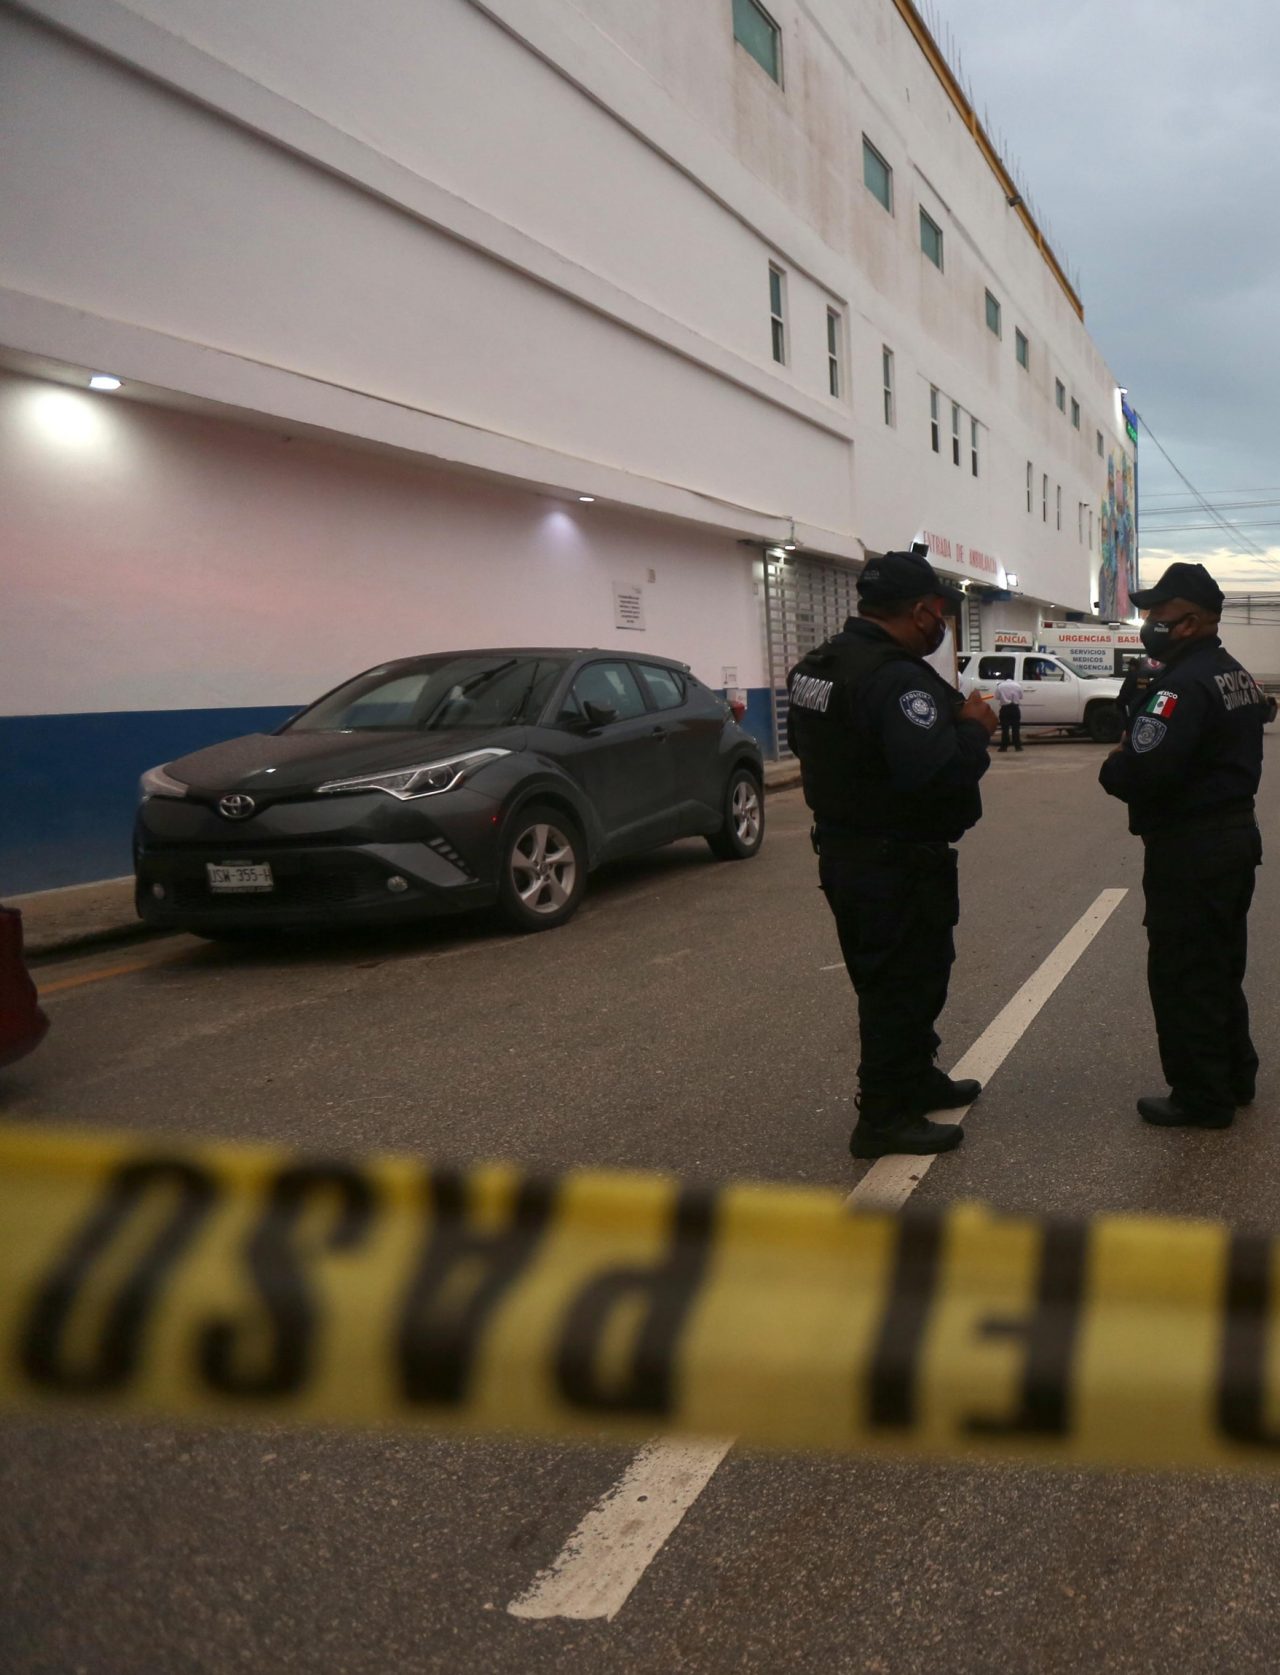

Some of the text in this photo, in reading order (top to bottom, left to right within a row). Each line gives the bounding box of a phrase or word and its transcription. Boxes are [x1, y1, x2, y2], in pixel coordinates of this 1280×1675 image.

[923, 530, 951, 559] ENTRADA
[956, 543, 964, 563] DE
[1058, 634, 1112, 643] URGENCIAS
[1070, 648, 1106, 656] SERVICIOS
[18, 1153, 722, 1422] PASO
